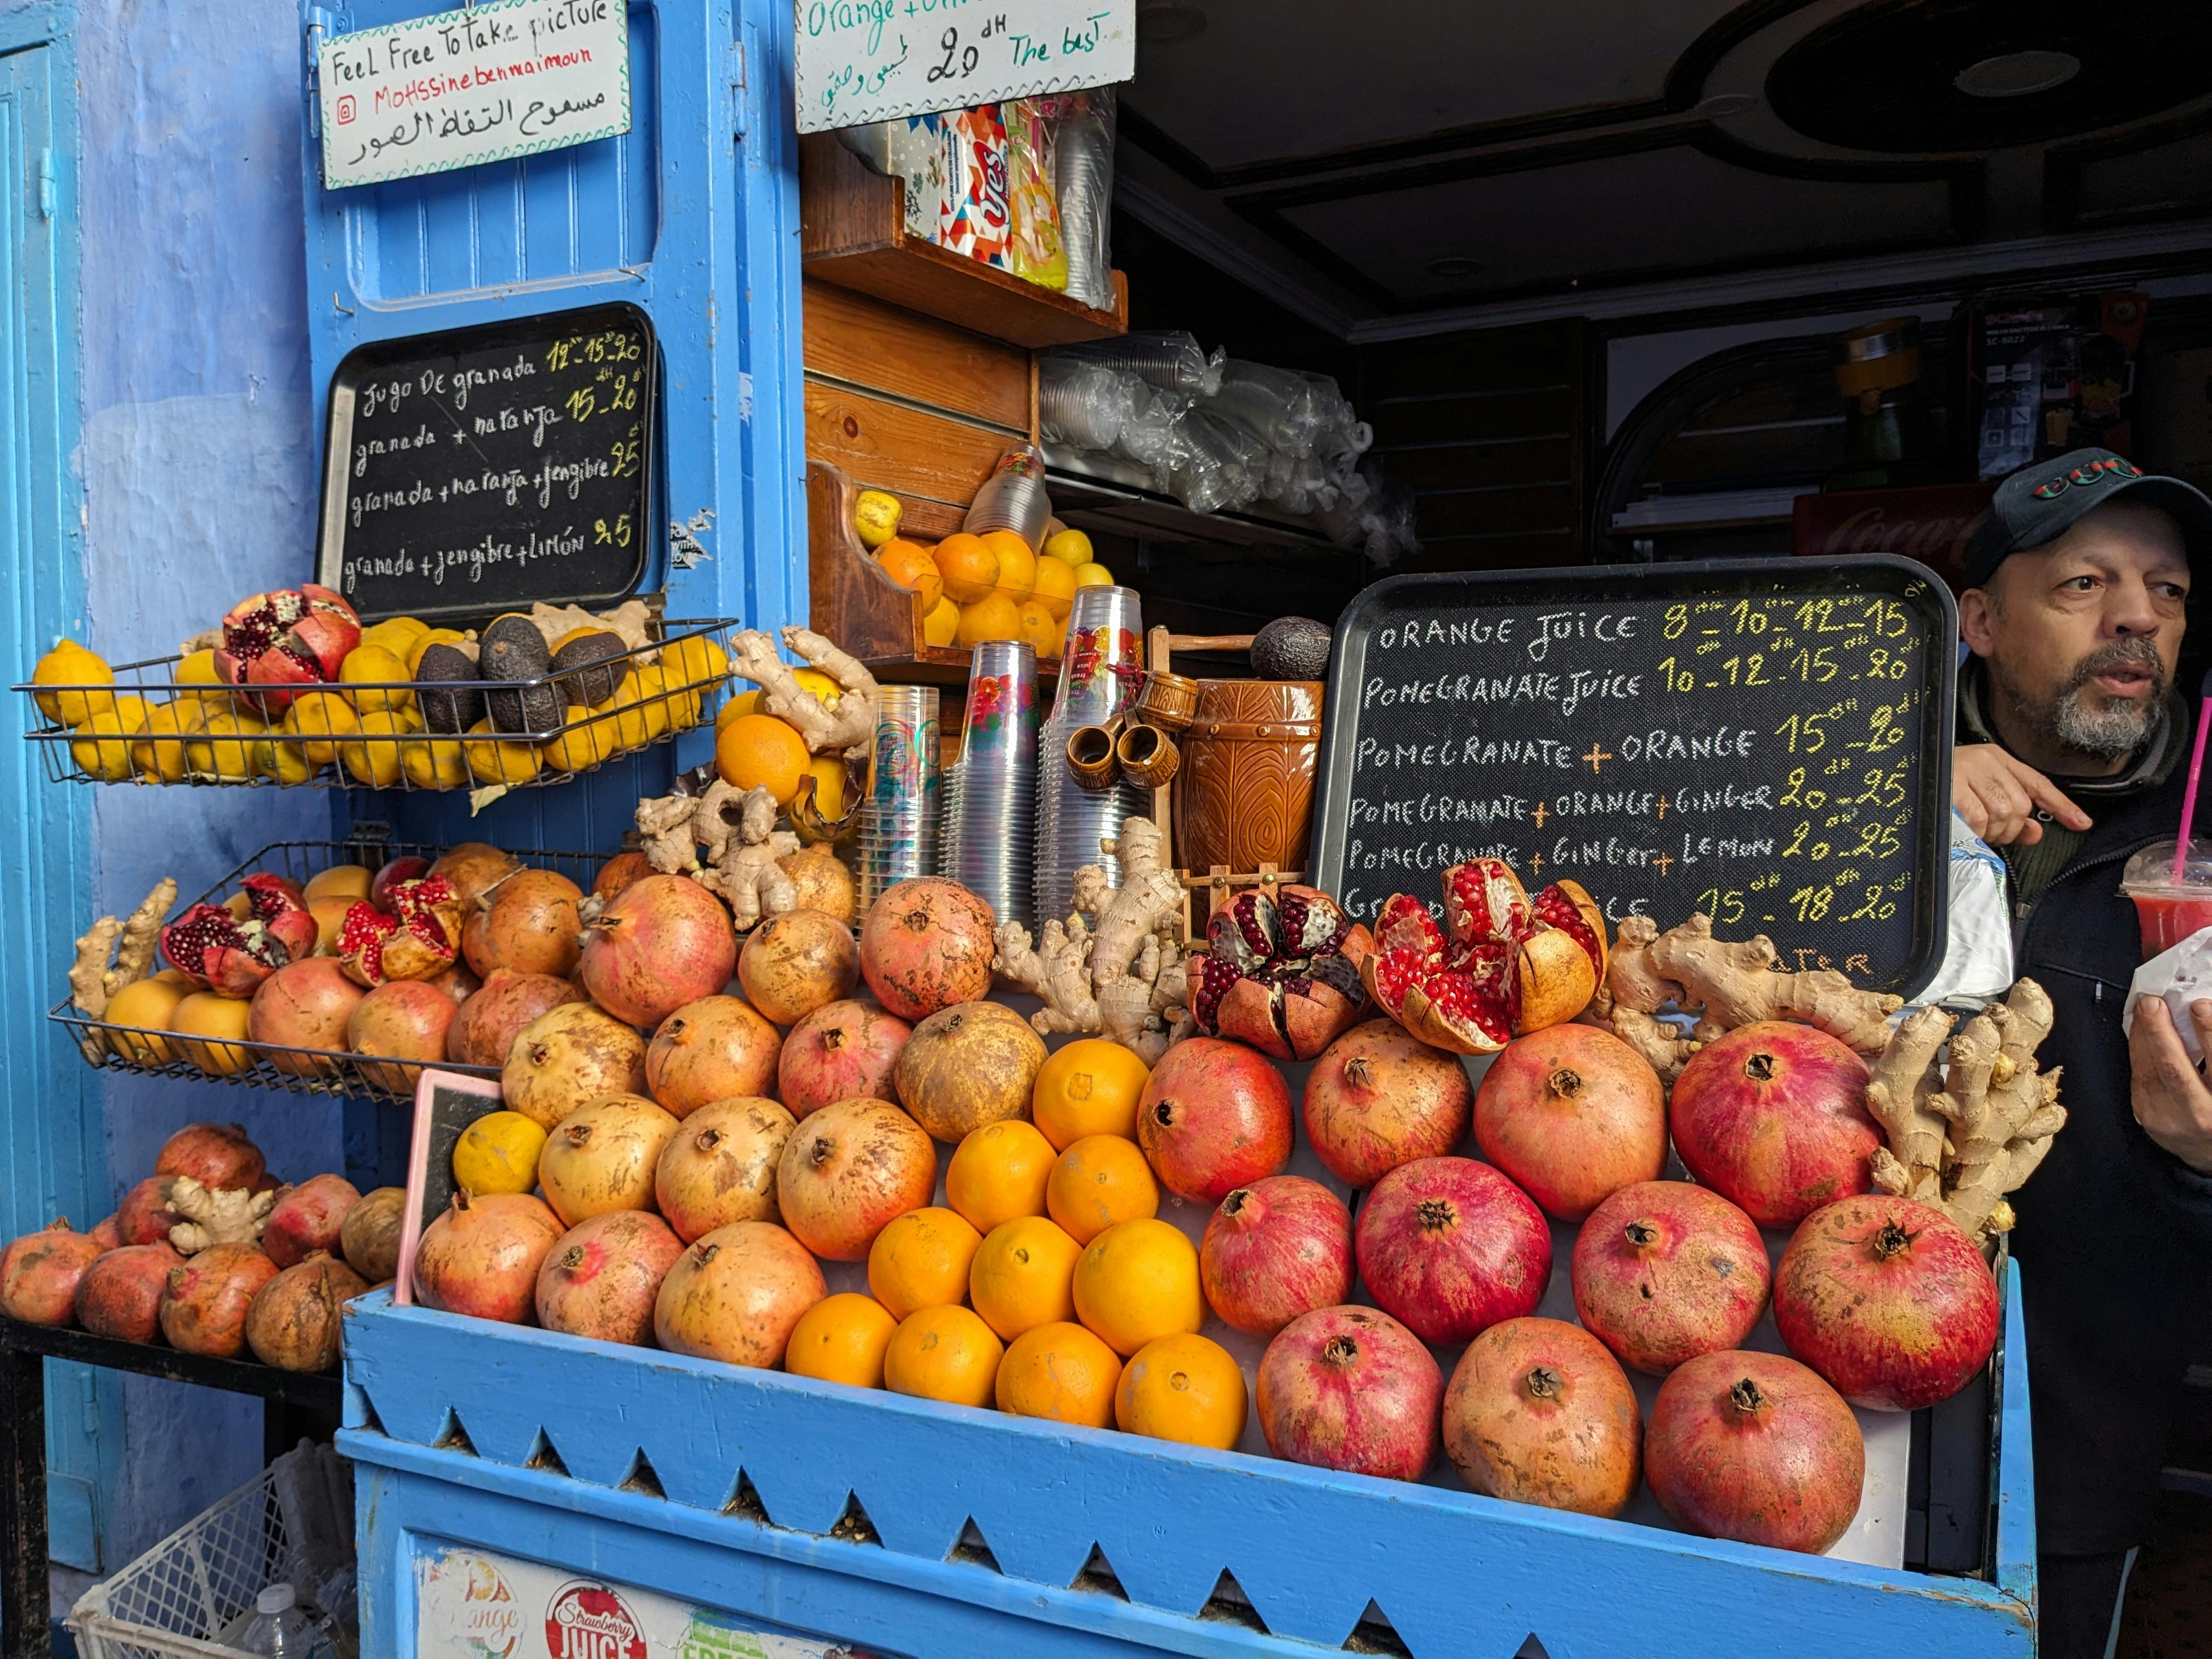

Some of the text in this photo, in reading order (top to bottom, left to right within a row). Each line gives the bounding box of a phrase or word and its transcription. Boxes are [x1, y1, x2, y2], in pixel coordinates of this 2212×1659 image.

[388, 37, 435, 70] Free
[809, 0, 895, 57] Orange
[1008, 34, 1052, 67] The
[927, 26, 980, 84] 20
[348, 111, 434, 166] الصور
[520, 92, 605, 137] مسموح
[453, 354, 537, 411] granada
[354, 424, 437, 478] granada
[565, 386, 596, 423] 15
[611, 374, 637, 411] 20
[351, 480, 434, 528] granada
[610, 439, 641, 479] 25
[344, 548, 416, 595] granada
[433, 534, 515, 586] jengibre
[1380, 618, 1515, 649] ORANGE
[1663, 603, 1688, 641] 8
[1730, 599, 1769, 634] 10
[1794, 598, 1844, 633] 12
[1864, 599, 1909, 639] 15
[1657, 656, 1695, 693] 10
[1722, 653, 1771, 686] 12
[1790, 646, 1839, 682] 15
[1866, 648, 1909, 680] 20
[1622, 725, 1757, 761] ORANGE
[1774, 714, 1827, 753] 15
[1866, 704, 1906, 753] 20
[1556, 790, 1655, 817] ORANGE
[1674, 783, 1774, 814] GINGER
[1780, 767, 1827, 810] 20
[1854, 769, 1906, 808] 25
[1782, 820, 1831, 861] 20
[1851, 822, 1902, 859] 25
[1697, 887, 1745, 925] 15
[1788, 884, 1836, 922] 18
[1851, 884, 1897, 920] 20
[1768, 947, 1874, 974] ATER
[558, 1602, 633, 1641] Strawberry
